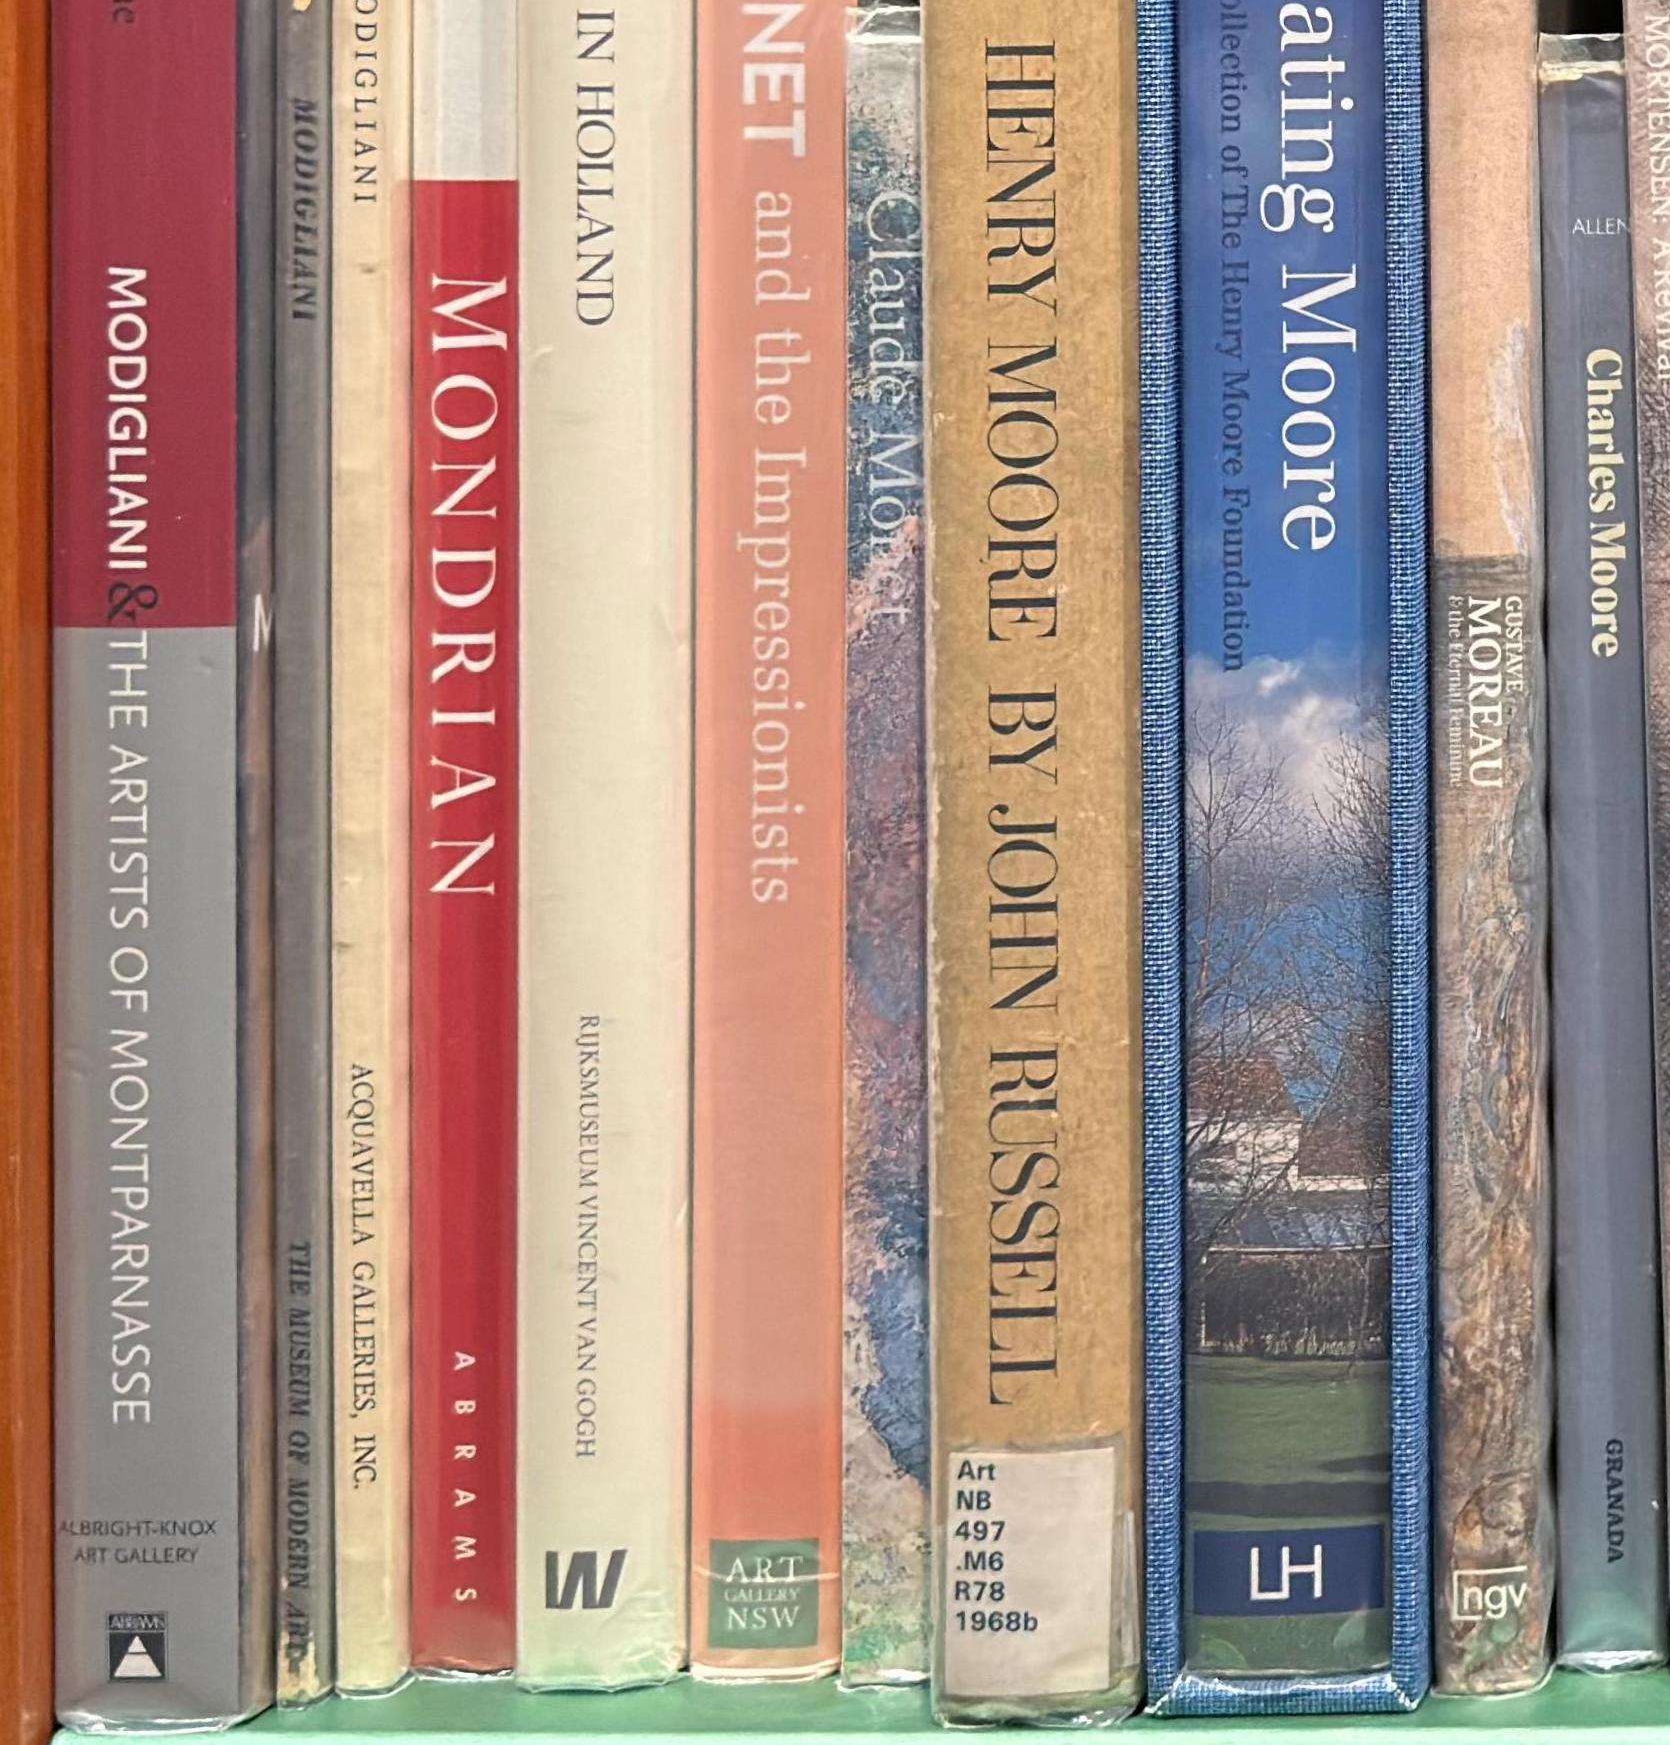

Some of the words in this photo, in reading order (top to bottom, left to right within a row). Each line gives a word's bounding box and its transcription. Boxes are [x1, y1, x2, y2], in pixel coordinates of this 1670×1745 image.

[576, 8, 615, 59] IN
[290, 97, 320, 322] MODIGLIANI
[576, 82, 616, 326] HOLLAND
[984, 39, 1057, 316] HENRY
[1220, 146, 1249, 177] of
[753, 190, 810, 305] and
[1220, 184, 1250, 249] The
[866, 190, 922, 406] Claude
[1214, 258, 1250, 358] Henry
[107, 266, 149, 569] MODIGLIANI
[753, 328, 810, 426] the
[1221, 370, 1250, 476] Moore
[1280, 264, 1357, 550] Moore
[1584, 349, 1625, 513] Charles
[866, 429, 922, 625] Monet
[985, 337, 1060, 641] MOORE
[107, 581, 159, 627] &
[427, 272, 509, 896] MONDRIAN
[1221, 486, 1250, 673] Foundation
[1448, 611, 1464, 638] the
[1588, 521, 1627, 657] Moore
[108, 631, 149, 729] THE
[736, 446, 808, 903] Impressionists
[1448, 643, 1465, 703] Eternal
[1468, 596, 1503, 789] MOREAU
[1504, 596, 1524, 693] GUSTAVE
[986, 683, 1058, 786] BY
[1449, 708, 1465, 787] Feminine
[107, 744, 150, 930] ARTISTS
[986, 803, 1060, 1012] JOHN
[108, 947, 150, 1013] OF
[575, 1013, 602, 1189] RIJKSMUSEUM
[346, 1063, 376, 1245] ACQUAVELLA
[109, 1029, 151, 1424] MONTPARNASSE
[288, 1242, 312, 1295] THE
[575, 1195, 600, 1311] VINCENT
[987, 1044, 1061, 1406] RUSSELL
[287, 1307, 312, 1417] MUSEUM
[349, 1261, 376, 1420] GALLERIES,
[575, 1317, 599, 1371] VAN
[288, 1430, 311, 1465] OF
[352, 1435, 378, 1491] INC.
[573, 1379, 599, 1458] GOGH
[451, 1351, 477, 1602] ABRAMS
[956, 1460, 996, 1481] Art
[956, 1489, 993, 1511] NB
[1603, 1438, 1627, 1564] GRANADA
[60, 1520, 217, 1536] ALBRIGHT-KNOX
[75, 1548, 106, 1563] ART
[115, 1548, 198, 1563] GALLERY
[286, 1478, 311, 1589] MODERN
[725, 1556, 804, 1583] ART
[954, 1519, 1006, 1543] 497
[956, 1550, 1005, 1572] .M6
[724, 1588, 800, 1603] GALLERY
[727, 1606, 800, 1630] NSW
[953, 1581, 1006, 1602] R78
[955, 1611, 1039, 1633] 1968b
[1464, 1583, 1527, 1619] ngv
